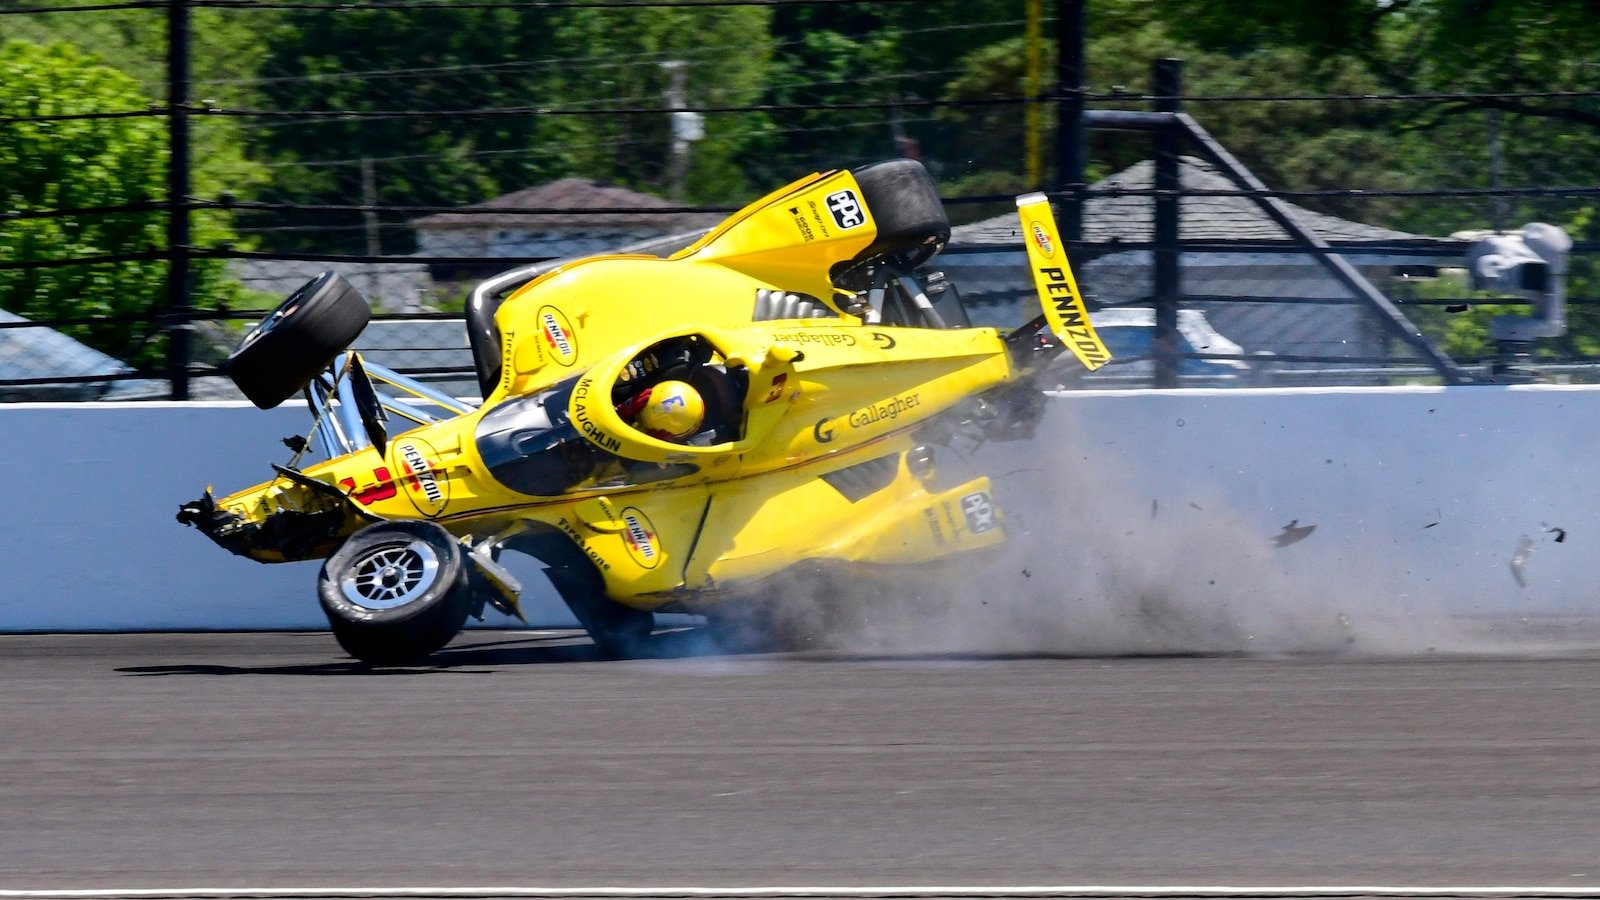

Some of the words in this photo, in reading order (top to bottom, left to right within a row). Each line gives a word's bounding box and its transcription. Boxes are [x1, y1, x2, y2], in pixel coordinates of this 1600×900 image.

[830, 191, 861, 228] PPG
[544, 313, 571, 356] PENNZOIL
[772, 332, 856, 347] Gallagher
[1040, 267, 1108, 367] PENNZOIL
[504, 331, 515, 392] Firestone
[575, 378, 622, 452] MCLAUGHLIN
[814, 417, 836, 444] G
[849, 393, 921, 429] Gallagher
[400, 444, 443, 505] PENNZOIL
[558, 517, 611, 571] Firestone
[626, 516, 654, 558] PENNZOIL
